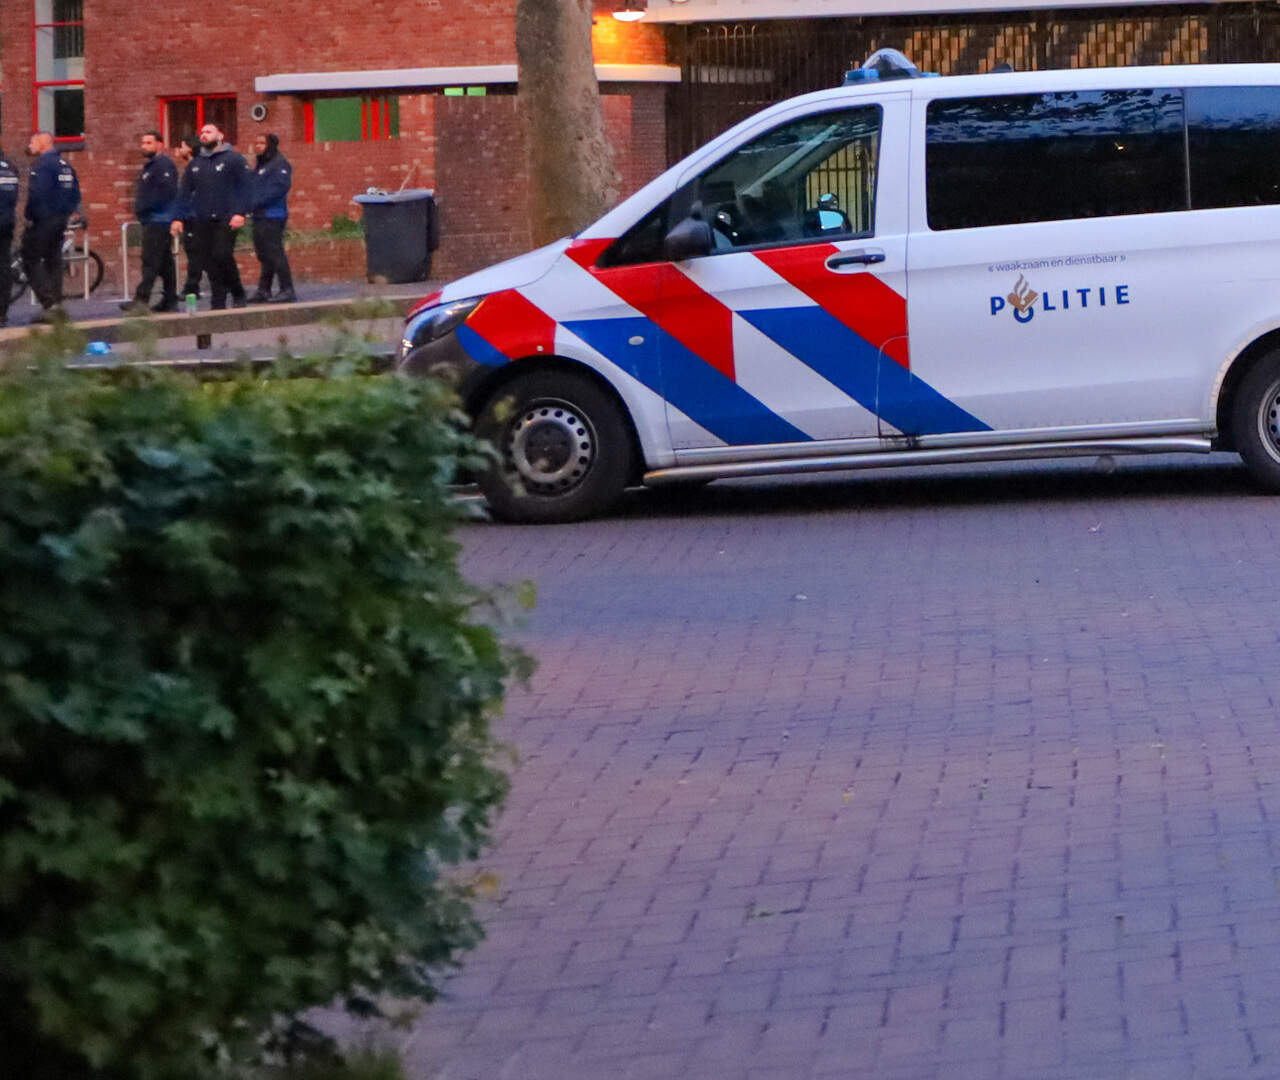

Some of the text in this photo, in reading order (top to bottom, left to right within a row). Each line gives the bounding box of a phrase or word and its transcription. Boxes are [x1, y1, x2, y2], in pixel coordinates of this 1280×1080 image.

[996, 259, 1050, 272] waakzaam
[1065, 254, 1118, 266] dienstbaar
[990, 285, 1130, 323] POLITIE
